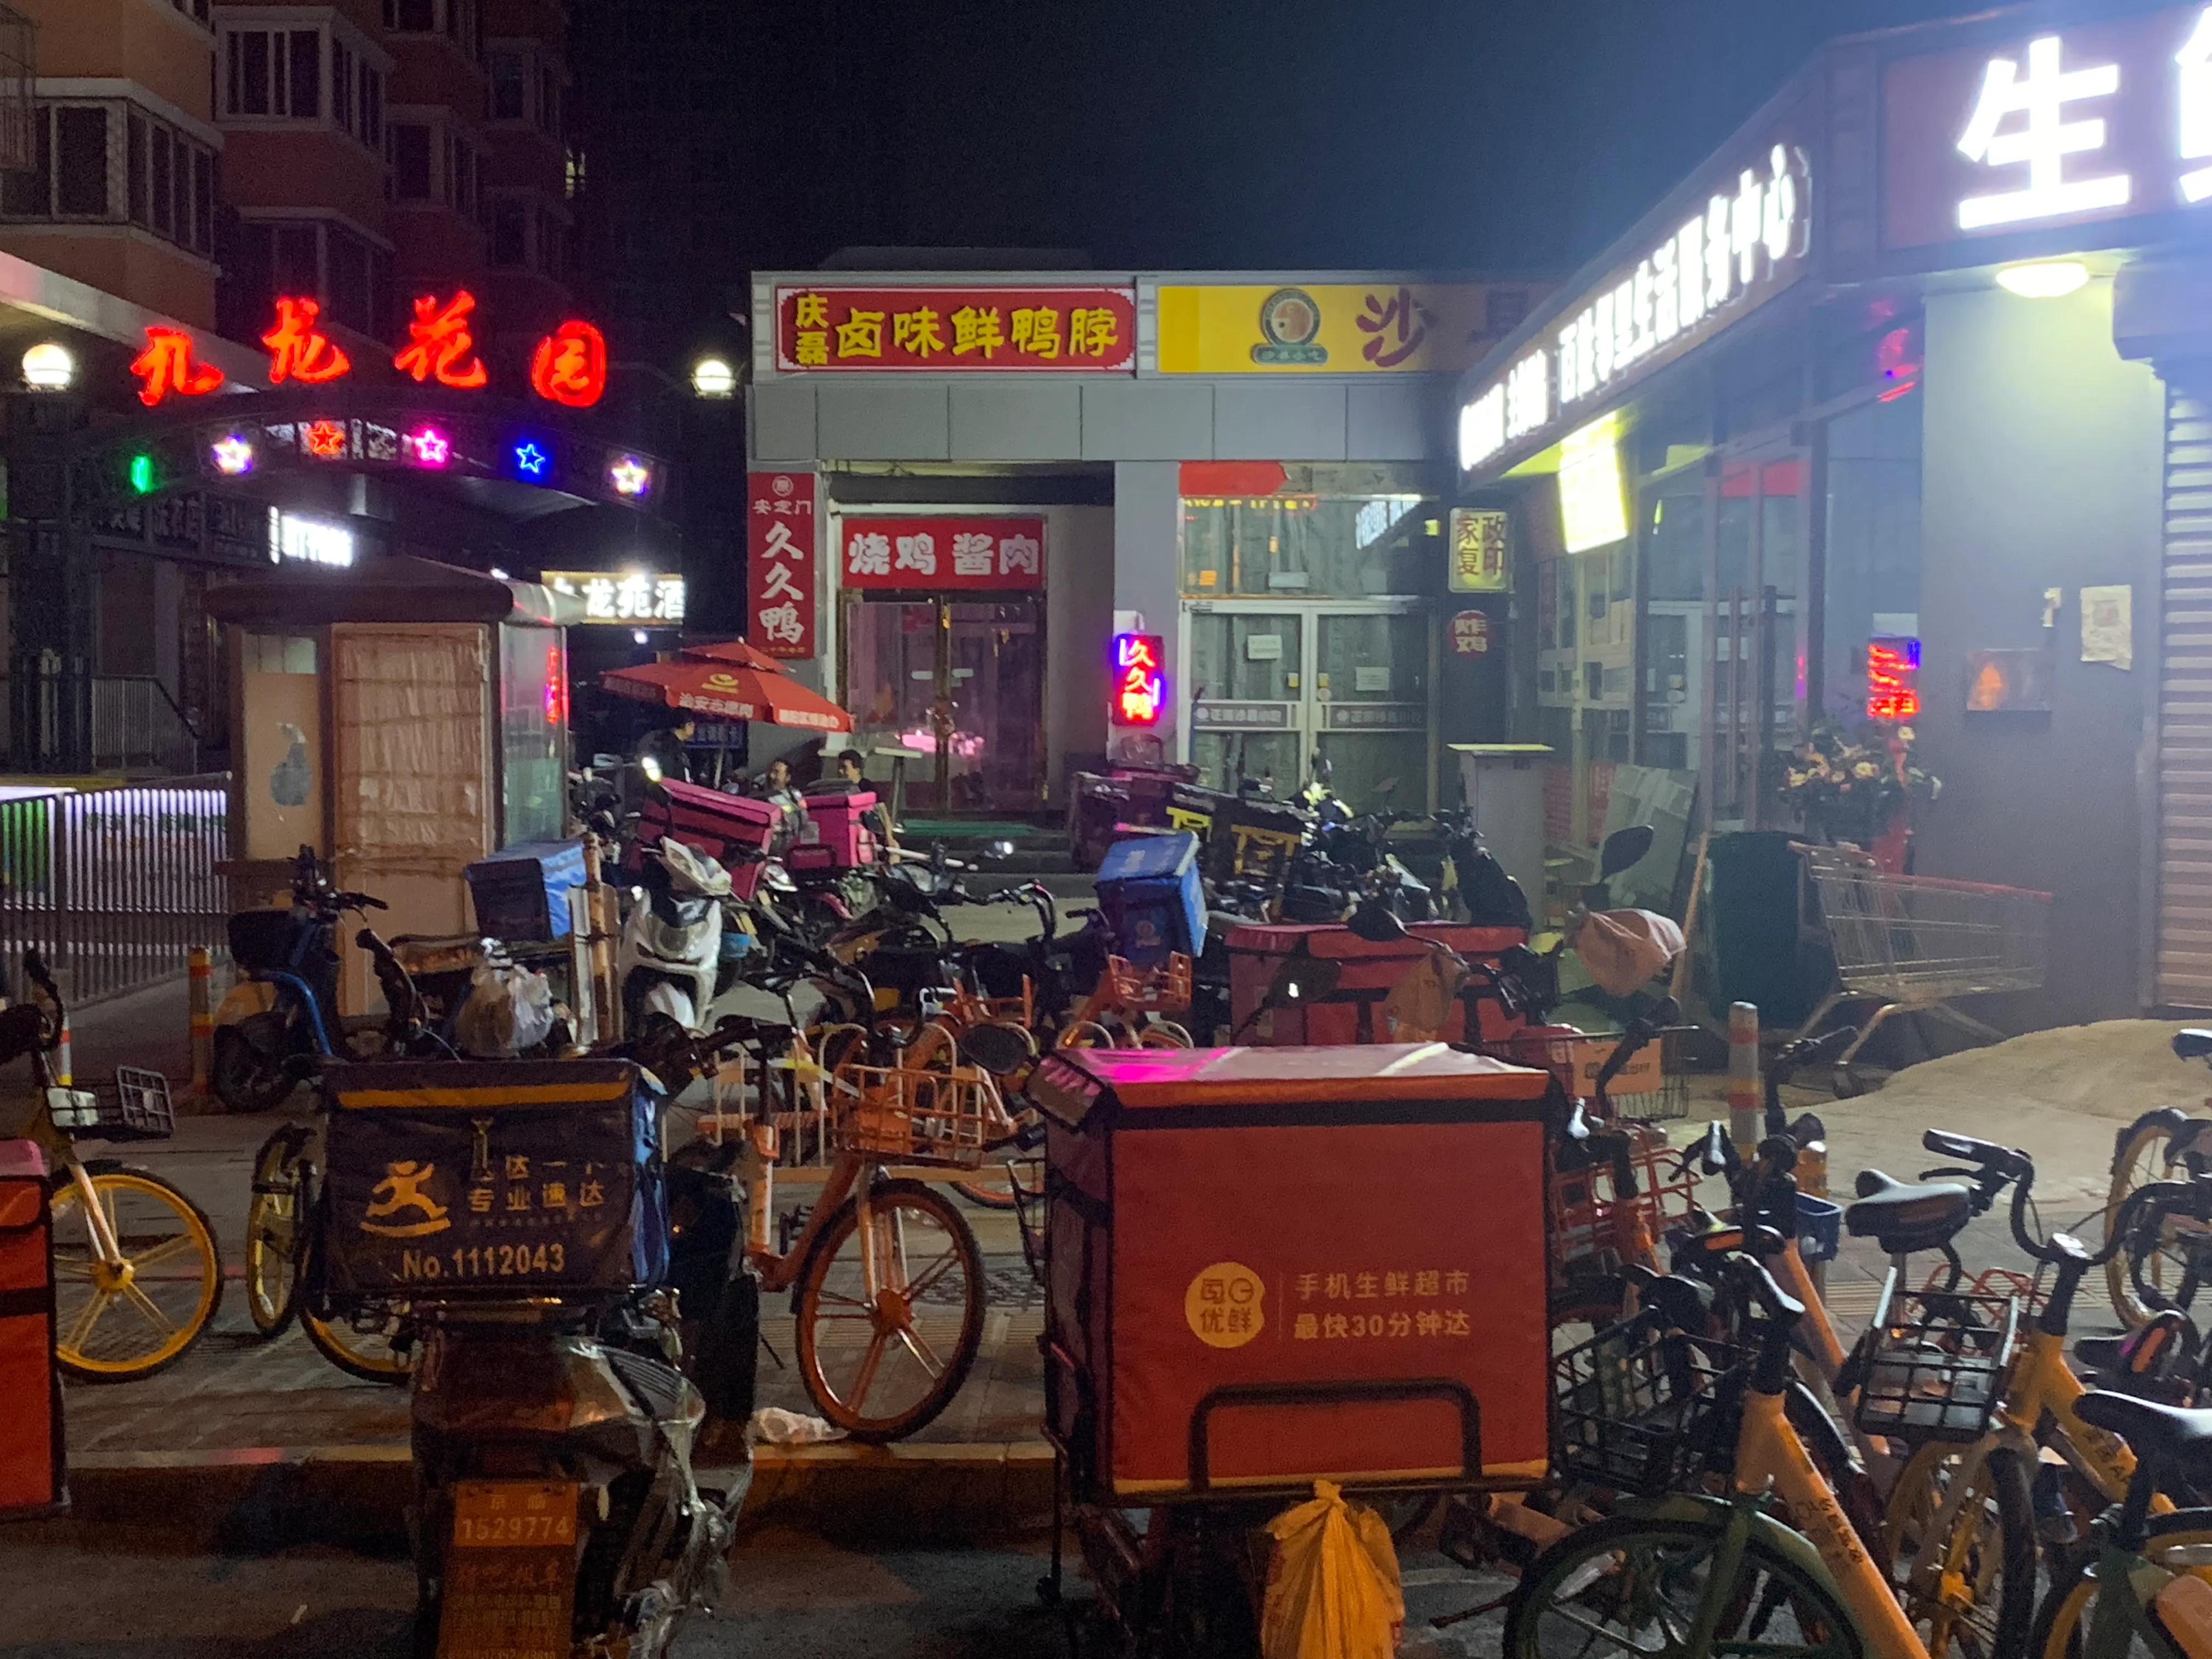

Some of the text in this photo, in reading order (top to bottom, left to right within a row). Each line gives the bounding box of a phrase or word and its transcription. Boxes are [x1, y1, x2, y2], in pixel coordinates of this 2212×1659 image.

[131, 291, 606, 408] 九龙花园
[795, 294, 828, 366] 庆磊
[835, 305, 1118, 359] 卤味鲜鸭脖
[848, 532, 1039, 575] 烧鸡 酱肉
[554, 573, 685, 619] 龙苑酒
[758, 520, 804, 644] 久久鸭
[1121, 639, 1155, 720] 久久鸭
[402, 1243, 565, 1278] No.1112043
[1295, 1269, 1470, 1301] 手机生鲜超市
[1294, 1311, 1471, 1340] 最快30分钟达
[462, 1516, 569, 1540] 1529774
